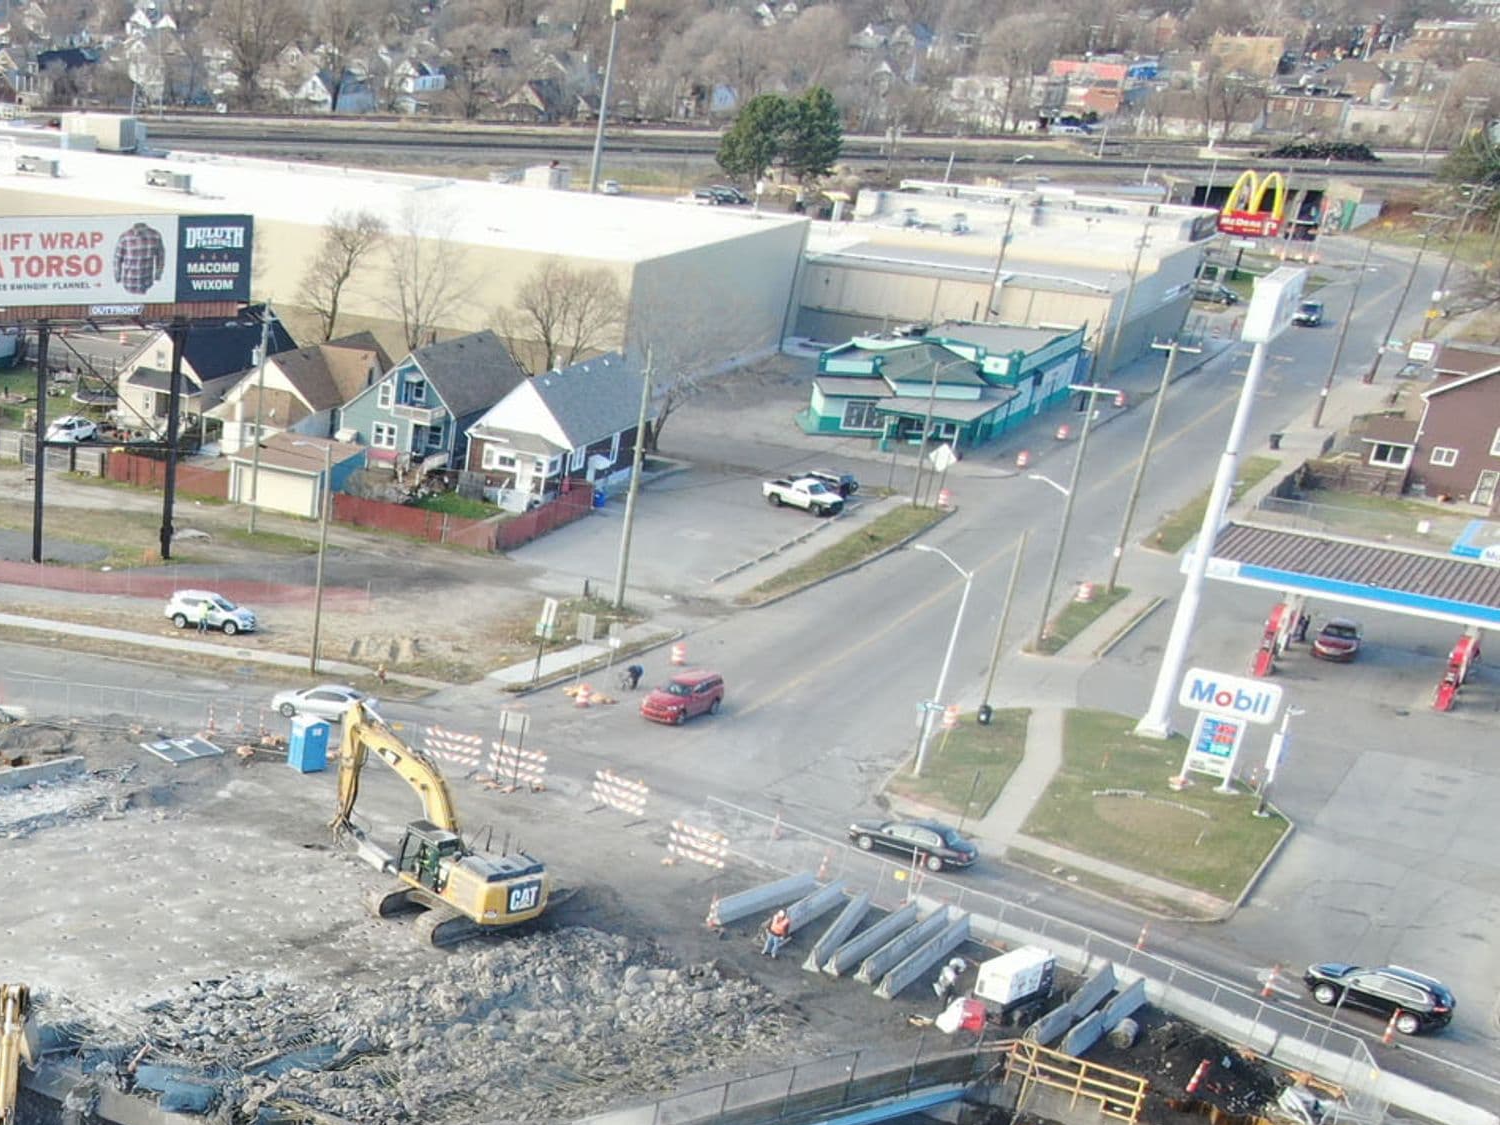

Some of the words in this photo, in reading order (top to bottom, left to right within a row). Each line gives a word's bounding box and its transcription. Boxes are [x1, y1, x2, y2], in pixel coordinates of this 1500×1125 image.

[39, 231, 104, 250] WRAP
[186, 227, 245, 249] DULUTH
[10, 254, 104, 278] TORSO
[187, 262, 240, 274] MACOMB
[52, 281, 92, 290] FLANNEL
[192, 279, 234, 291] WIXOM
[1189, 679, 1272, 716] Mobil
[510, 886, 539, 911] CAT
